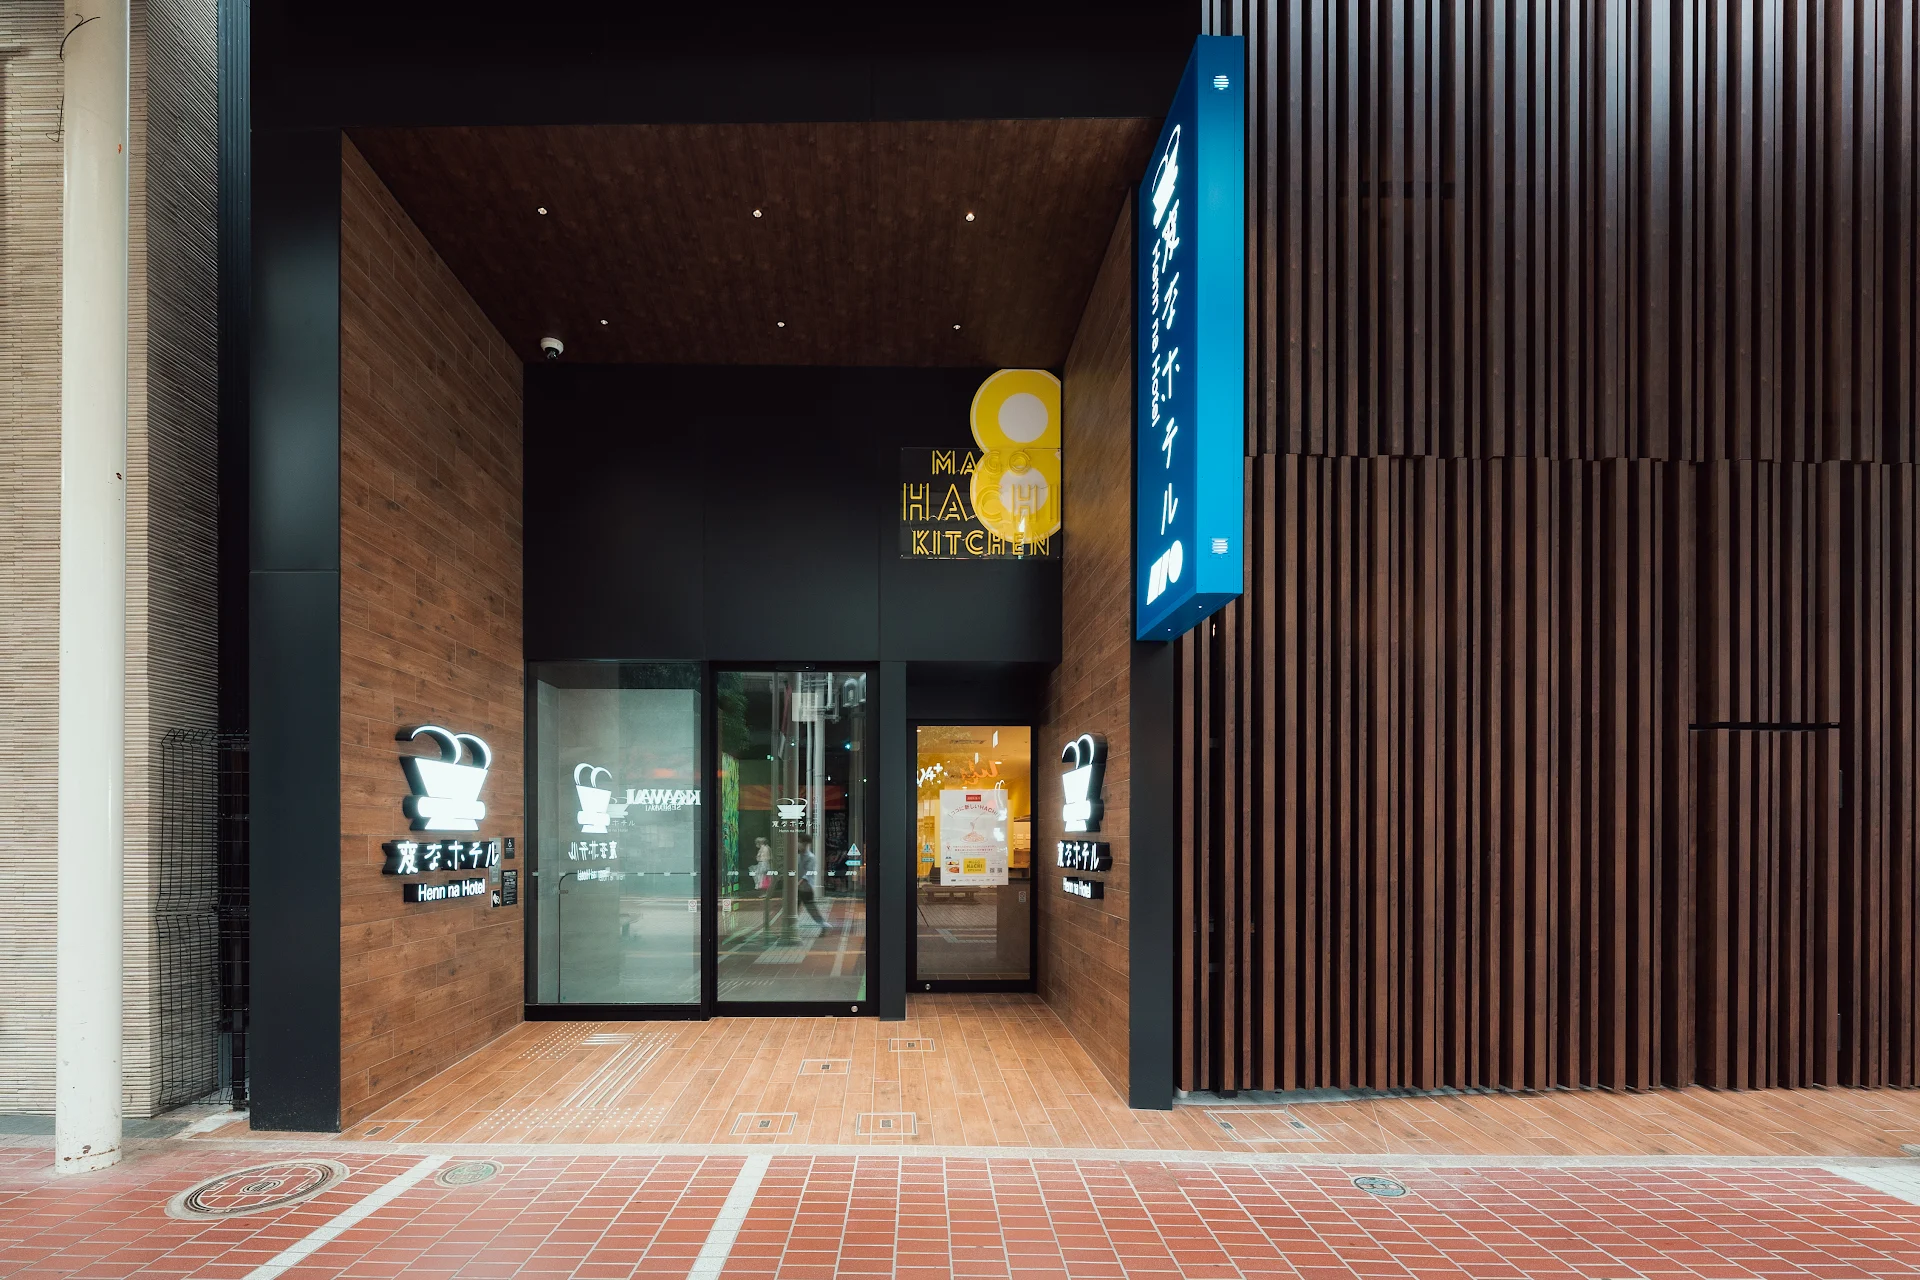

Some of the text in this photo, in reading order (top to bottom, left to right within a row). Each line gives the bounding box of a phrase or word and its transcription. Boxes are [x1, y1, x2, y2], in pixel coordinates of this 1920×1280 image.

[1152, 239, 1161, 428] Henn na Hotel
[1161, 199, 1179, 536] 変なホテル
[932, 450, 1031, 475] MAGO
[903, 483, 1061, 524] HACHI
[912, 530, 1050, 556] KITCHEN
[397, 840, 500, 874] 変なホテル
[1057, 841, 1099, 871] 変なホテル
[418, 884, 446, 902] Henn
[448, 885, 460, 898] na
[462, 878, 485, 897] Hotel
